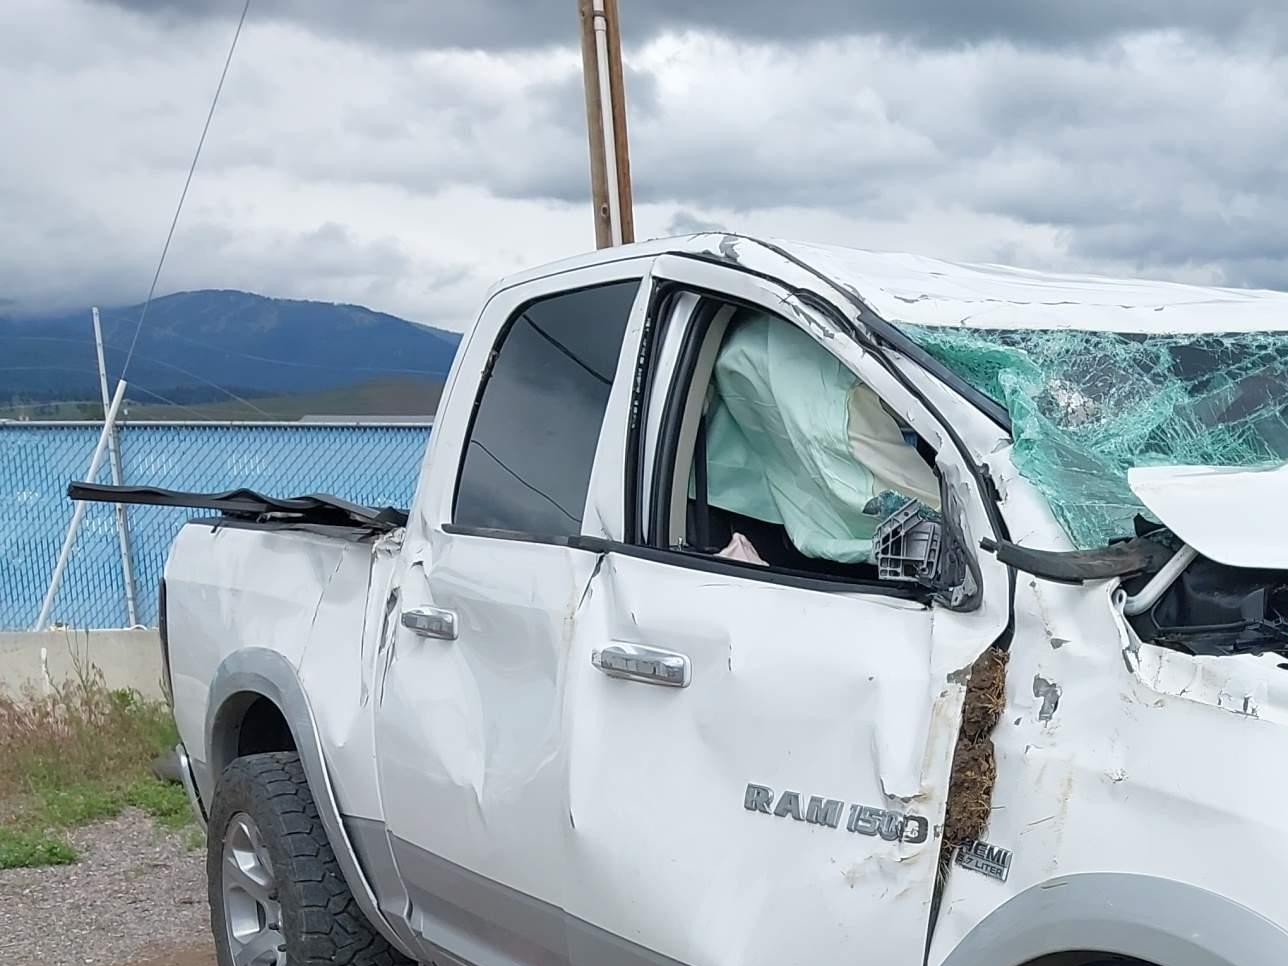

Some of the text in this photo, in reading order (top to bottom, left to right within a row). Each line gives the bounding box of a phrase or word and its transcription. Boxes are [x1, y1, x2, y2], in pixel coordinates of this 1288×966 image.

[744, 783, 928, 844] RAM 1500
[975, 860, 1003, 877] LITER
